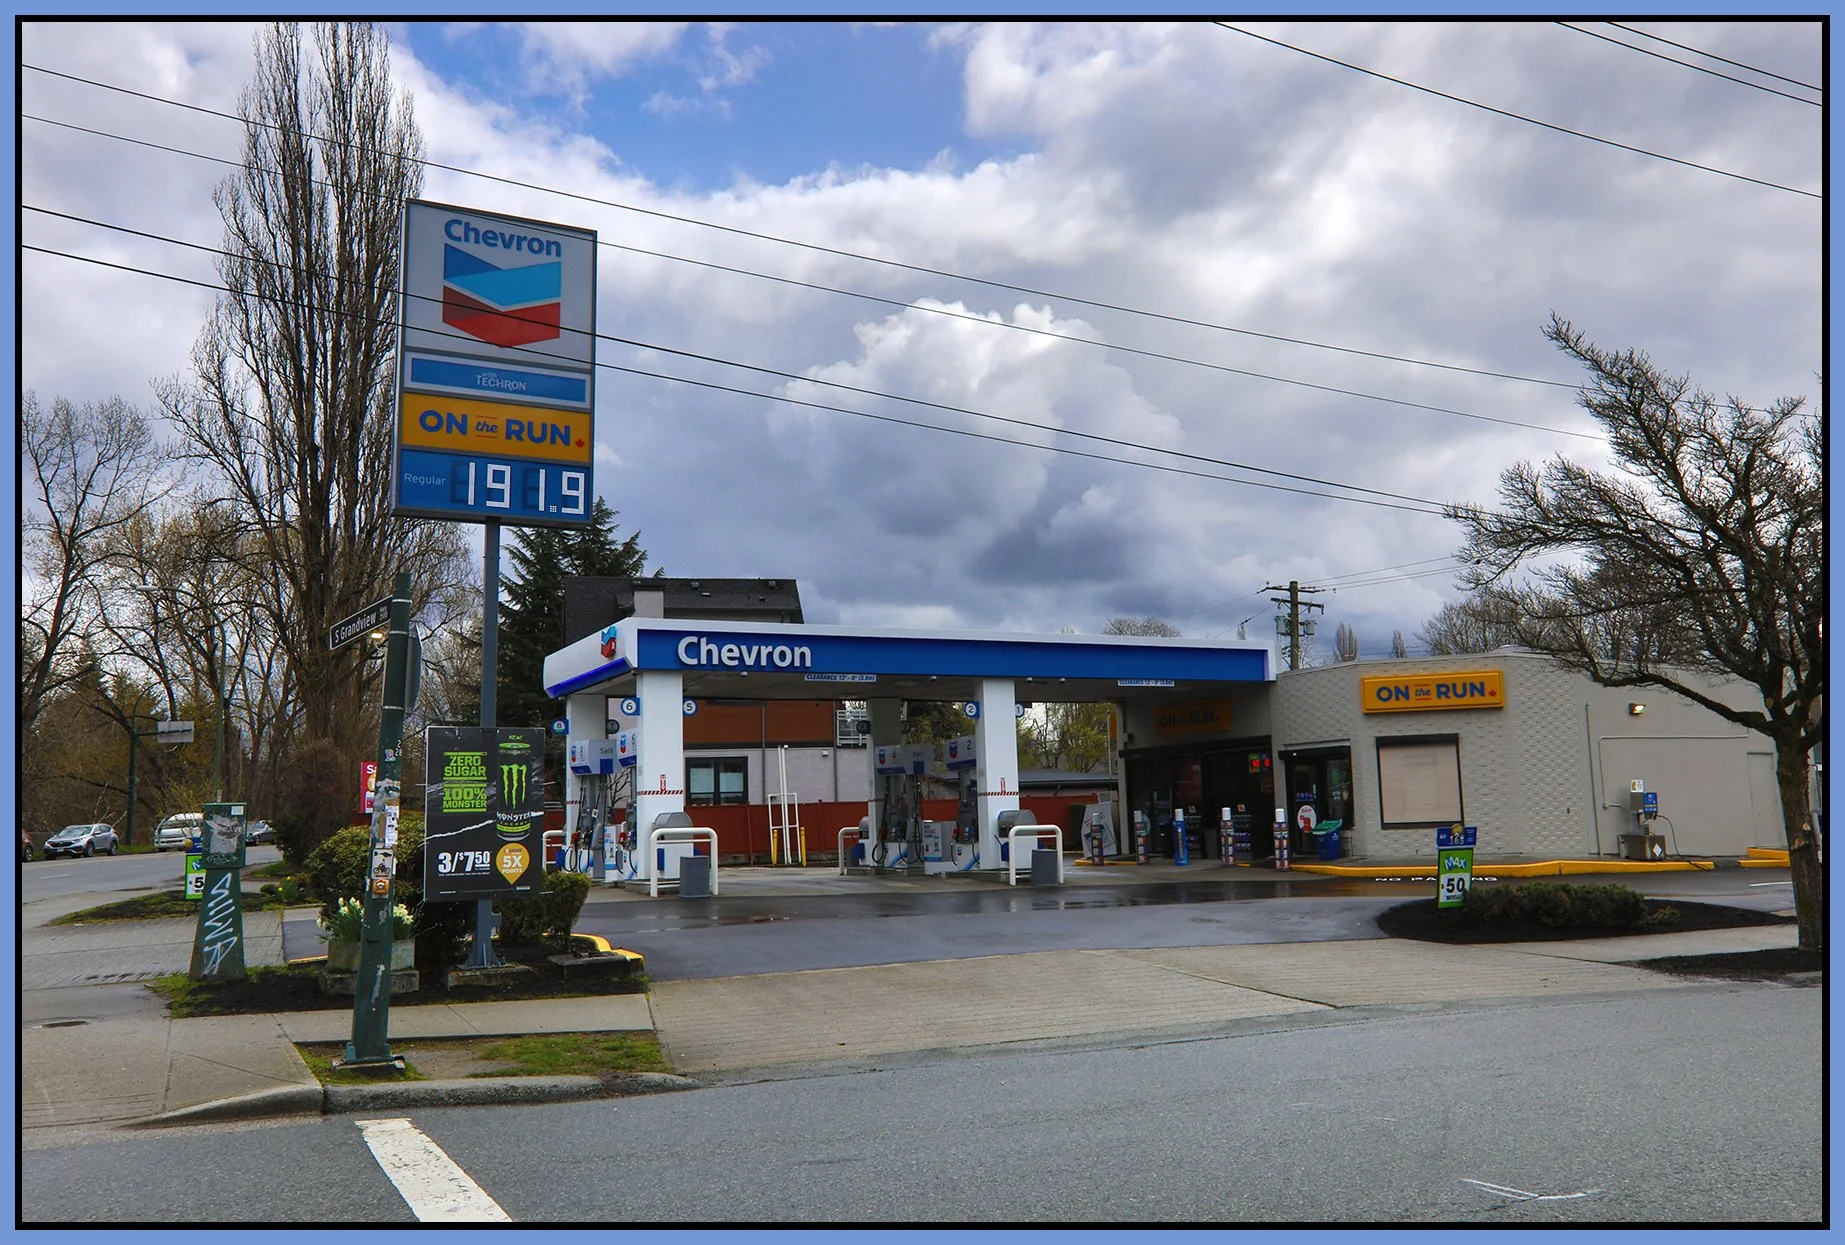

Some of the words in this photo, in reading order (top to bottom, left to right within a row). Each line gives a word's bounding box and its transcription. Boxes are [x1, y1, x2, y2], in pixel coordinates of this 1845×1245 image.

[444, 218, 562, 257] Chevron
[476, 374, 527, 391] TECHRON
[419, 410, 468, 436] ON
[475, 420, 498, 433] the
[505, 418, 571, 446] RUN
[404, 472, 446, 486] Regular
[334, 629, 339, 643] S
[340, 611, 377, 640] Grandview
[677, 636, 812, 668] Chevron
[806, 673, 838, 681] CLEARANCE
[1376, 685, 1410, 702] ON
[1415, 688, 1431, 697] the
[1436, 681, 1486, 700] RUN
[626, 702, 633, 711] 6
[686, 703, 693, 711] 5
[968, 705, 974, 714] 2
[556, 722, 562, 730] 8
[397, 739, 402, 748] 2
[966, 739, 972, 751] 2
[600, 747, 613, 755] Self
[449, 756, 482, 767] ZERO
[444, 766, 487, 777] SUGAR
[443, 787, 487, 801] 100%
[443, 800, 487, 809] MONSTER
[502, 855, 522, 868] 5X
[1444, 856, 1466, 871] MAX
